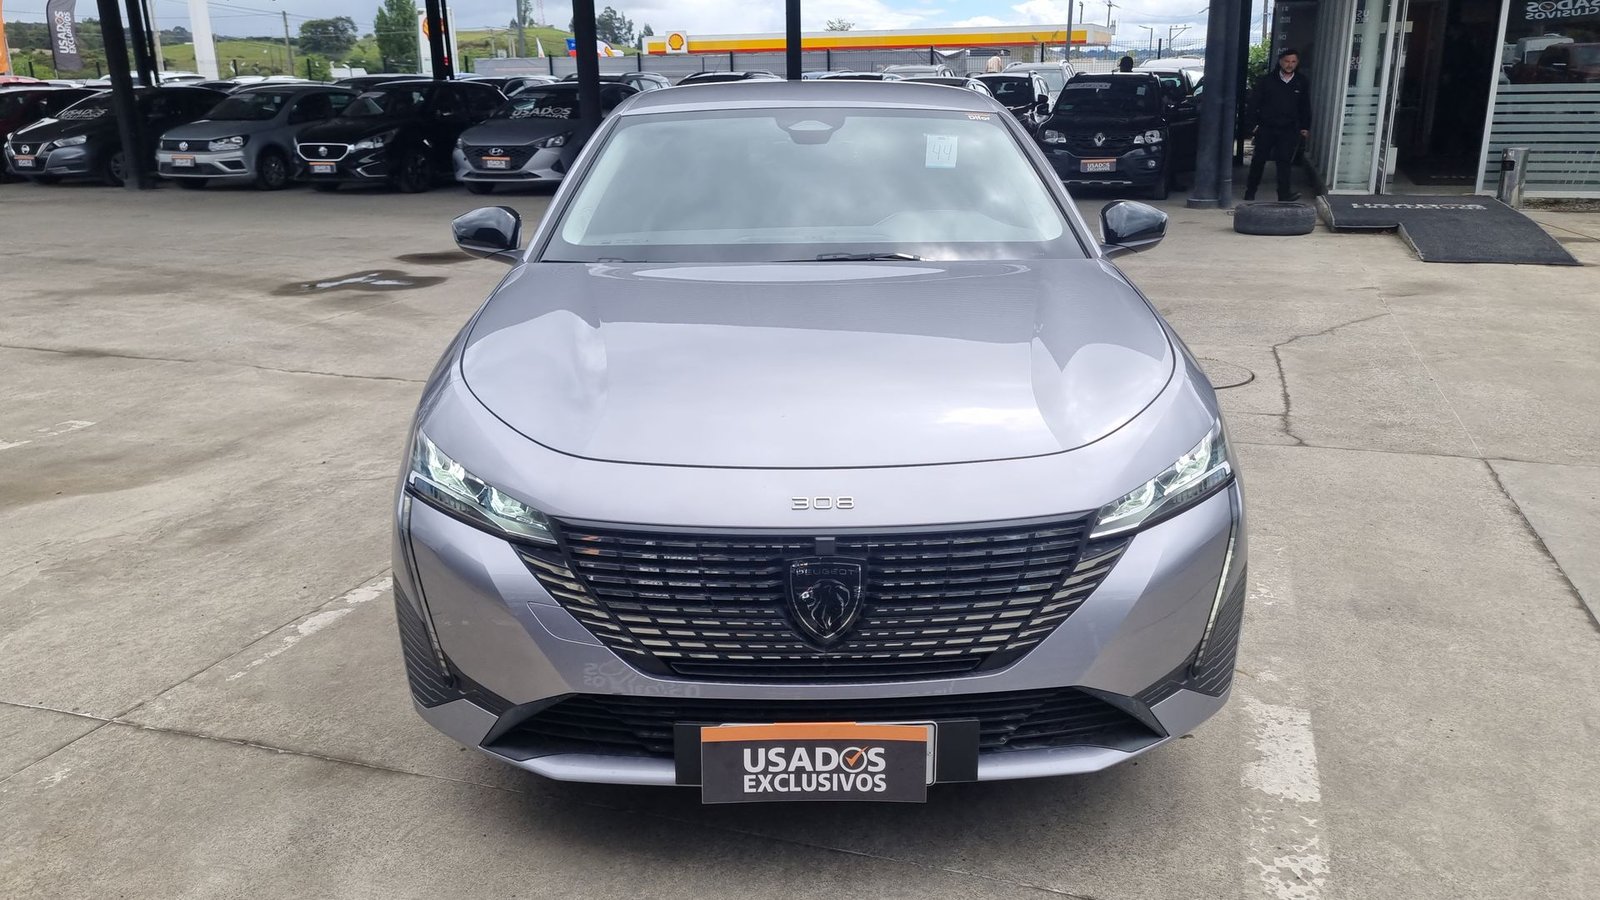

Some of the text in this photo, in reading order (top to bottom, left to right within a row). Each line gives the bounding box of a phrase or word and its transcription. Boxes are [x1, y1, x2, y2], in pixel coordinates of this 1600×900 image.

[55, 11, 69, 54] USADOS
[64, 11, 77, 54] EXCLUSIVOS
[931, 143, 953, 161] 44
[791, 496, 855, 510] 308
[796, 568, 854, 576] PEUGEOT
[743, 747, 886, 773] USADOS
[743, 773, 887, 793] EXCLUSIVOS
